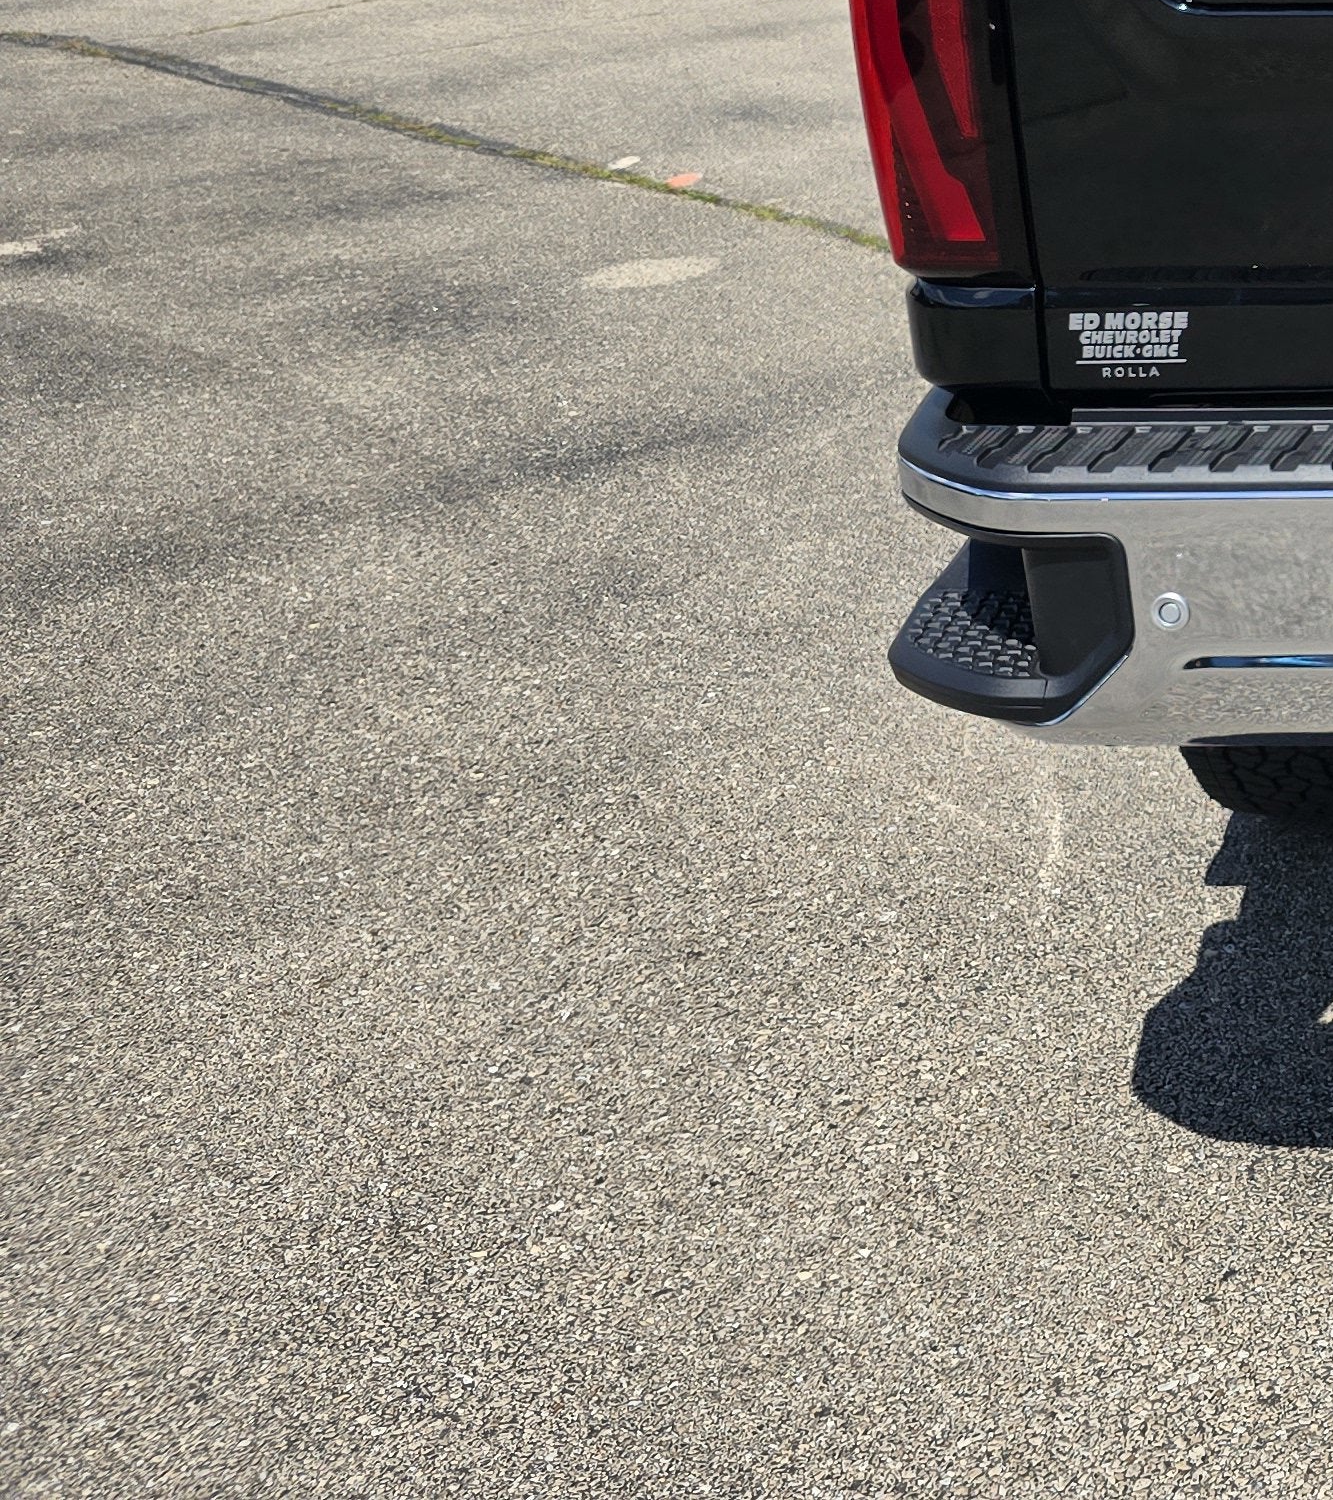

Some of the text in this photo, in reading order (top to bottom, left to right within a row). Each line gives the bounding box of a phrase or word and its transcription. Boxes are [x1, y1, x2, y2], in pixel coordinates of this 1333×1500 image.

[1068, 311, 1189, 331] ED MORSE
[1079, 329, 1182, 344] CHEVROLET
[1102, 366, 1161, 379] ROLLA
